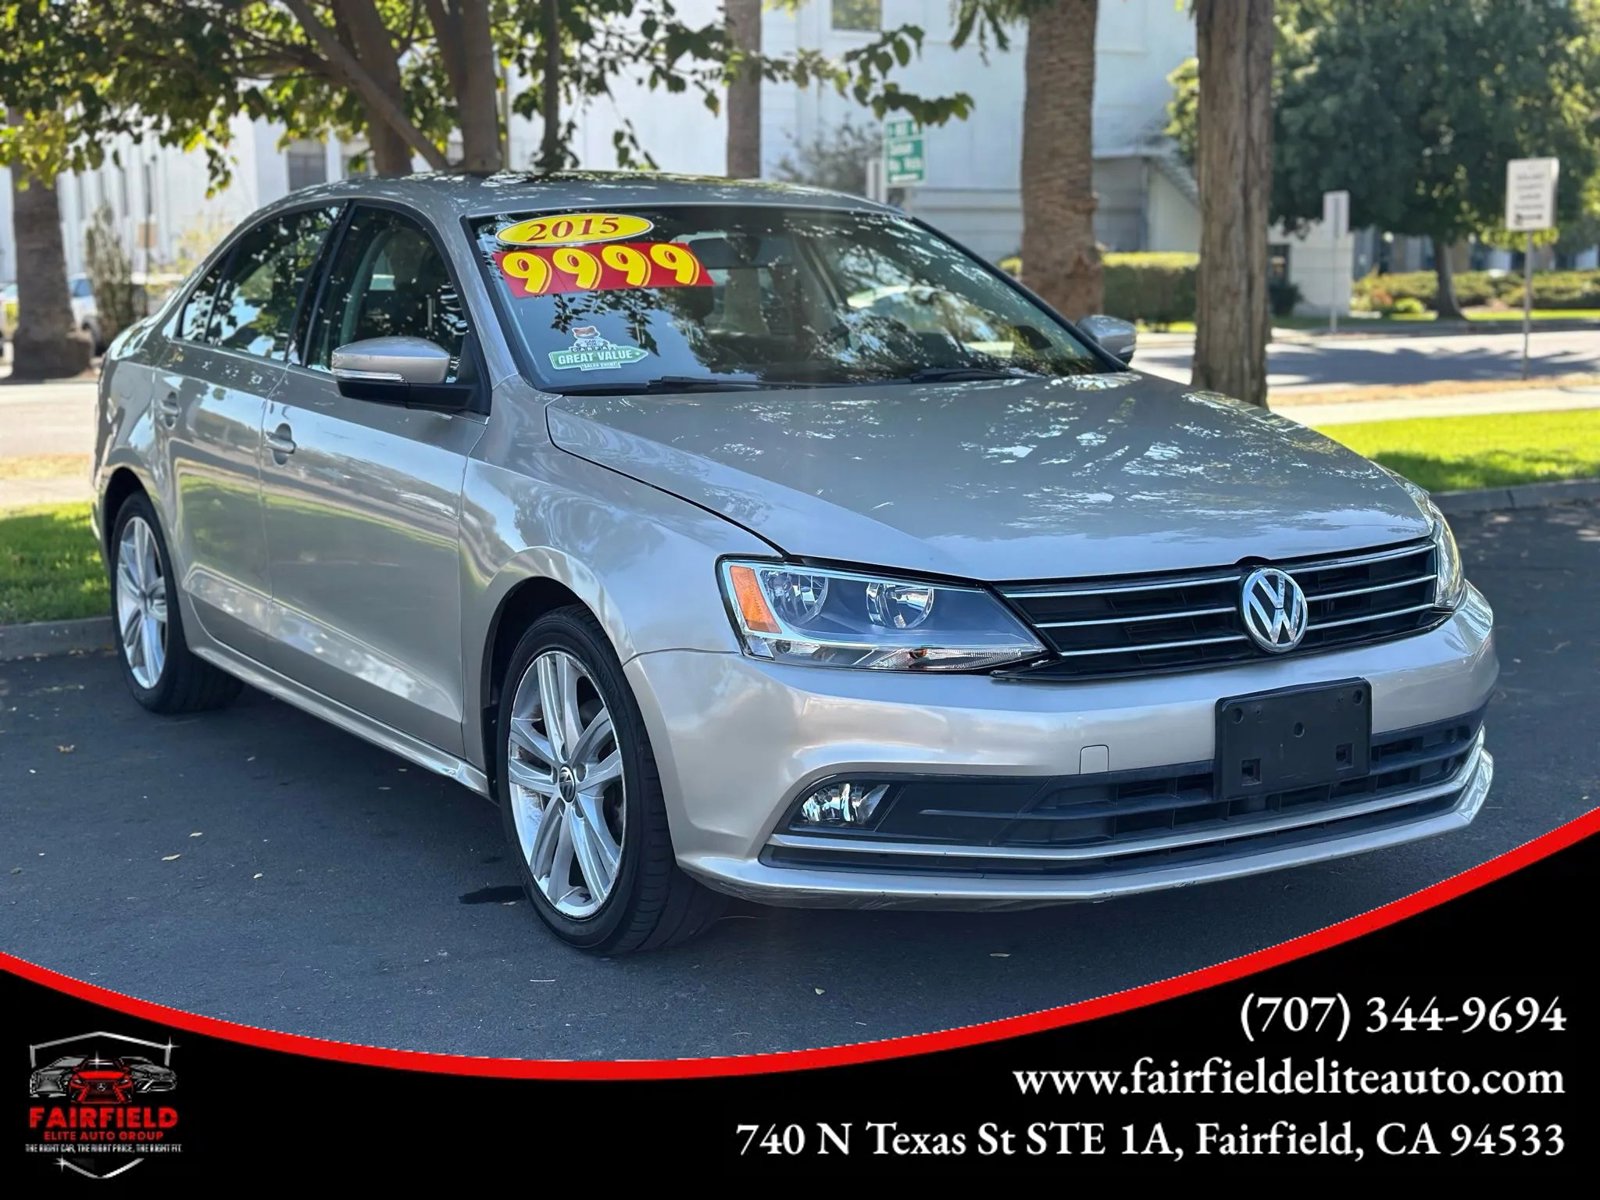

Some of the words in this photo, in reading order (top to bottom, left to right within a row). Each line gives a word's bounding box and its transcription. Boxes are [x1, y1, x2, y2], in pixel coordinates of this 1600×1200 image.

[526, 216, 620, 242] 2015
[502, 243, 700, 295] 9999
[558, 352, 593, 365] GREAT
[597, 349, 633, 361] VALUE
